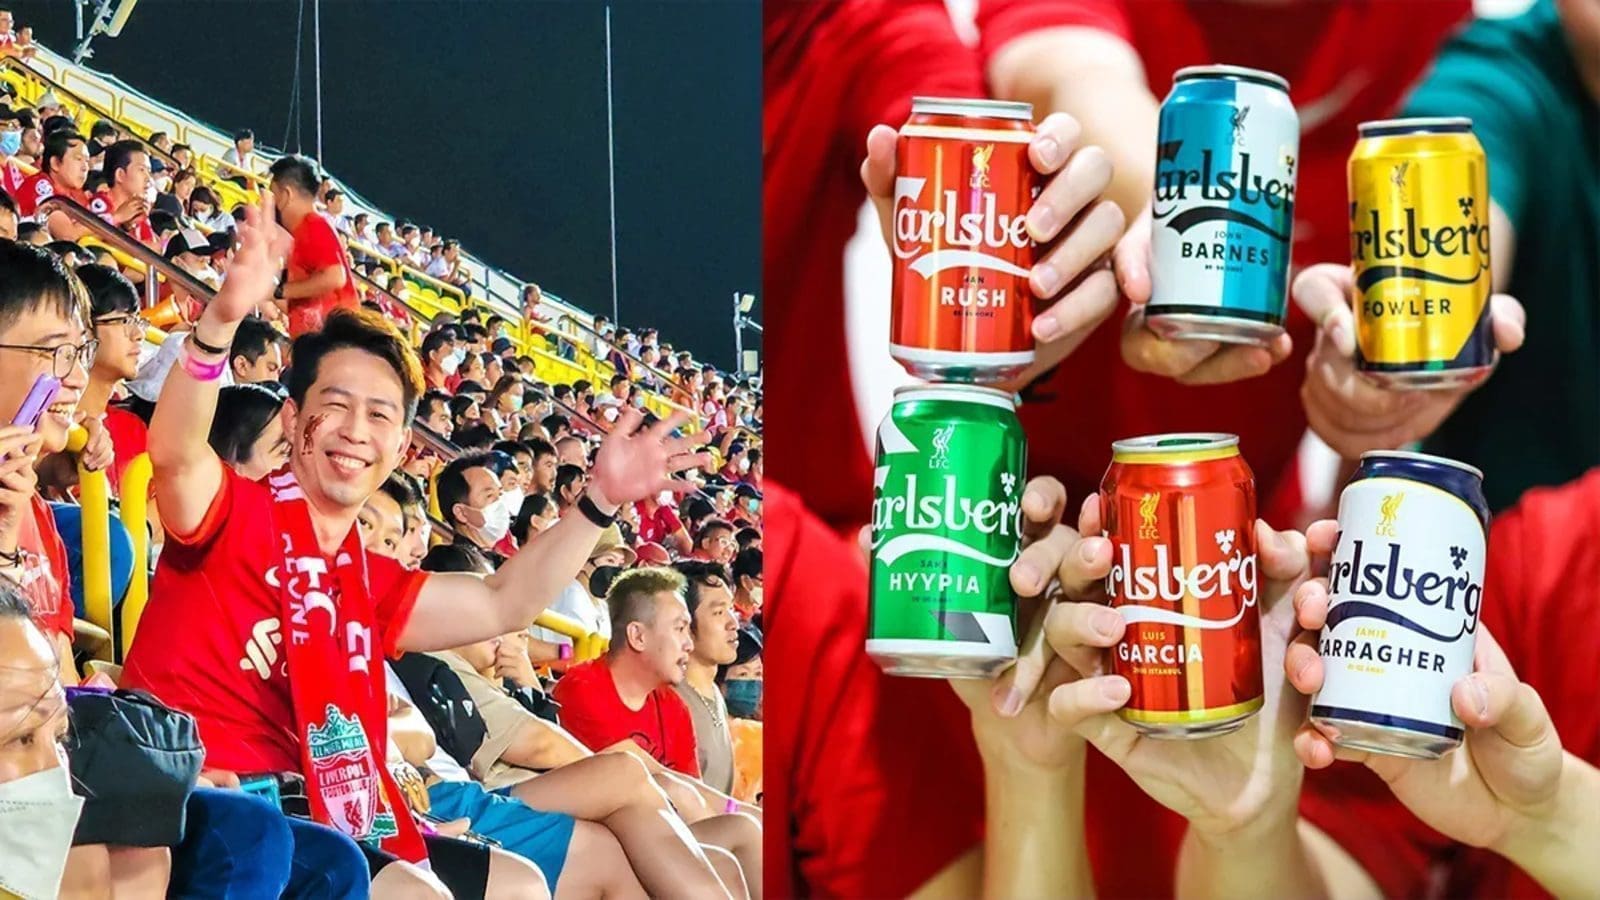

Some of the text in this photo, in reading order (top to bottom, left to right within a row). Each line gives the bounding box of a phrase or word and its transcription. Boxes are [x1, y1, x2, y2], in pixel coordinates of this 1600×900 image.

[893, 176, 1033, 259] Carlsbe
[1350, 201, 1490, 270] rlsberg
[1181, 242, 1270, 267] BARNES
[941, 286, 1006, 308] RUSH
[1363, 299, 1451, 317] FOWLER
[928, 459, 950, 469] LFC
[1138, 529, 1161, 540] LFC
[1375, 525, 1395, 537] LFC
[1103, 531, 1257, 607] rlsberg
[889, 573, 980, 594] HYYPIA
[1328, 531, 1482, 634] rlsberg
[1142, 631, 1166, 641] LUIS
[1355, 627, 1388, 639] JAMIE
[1118, 643, 1203, 664] GARCIA
